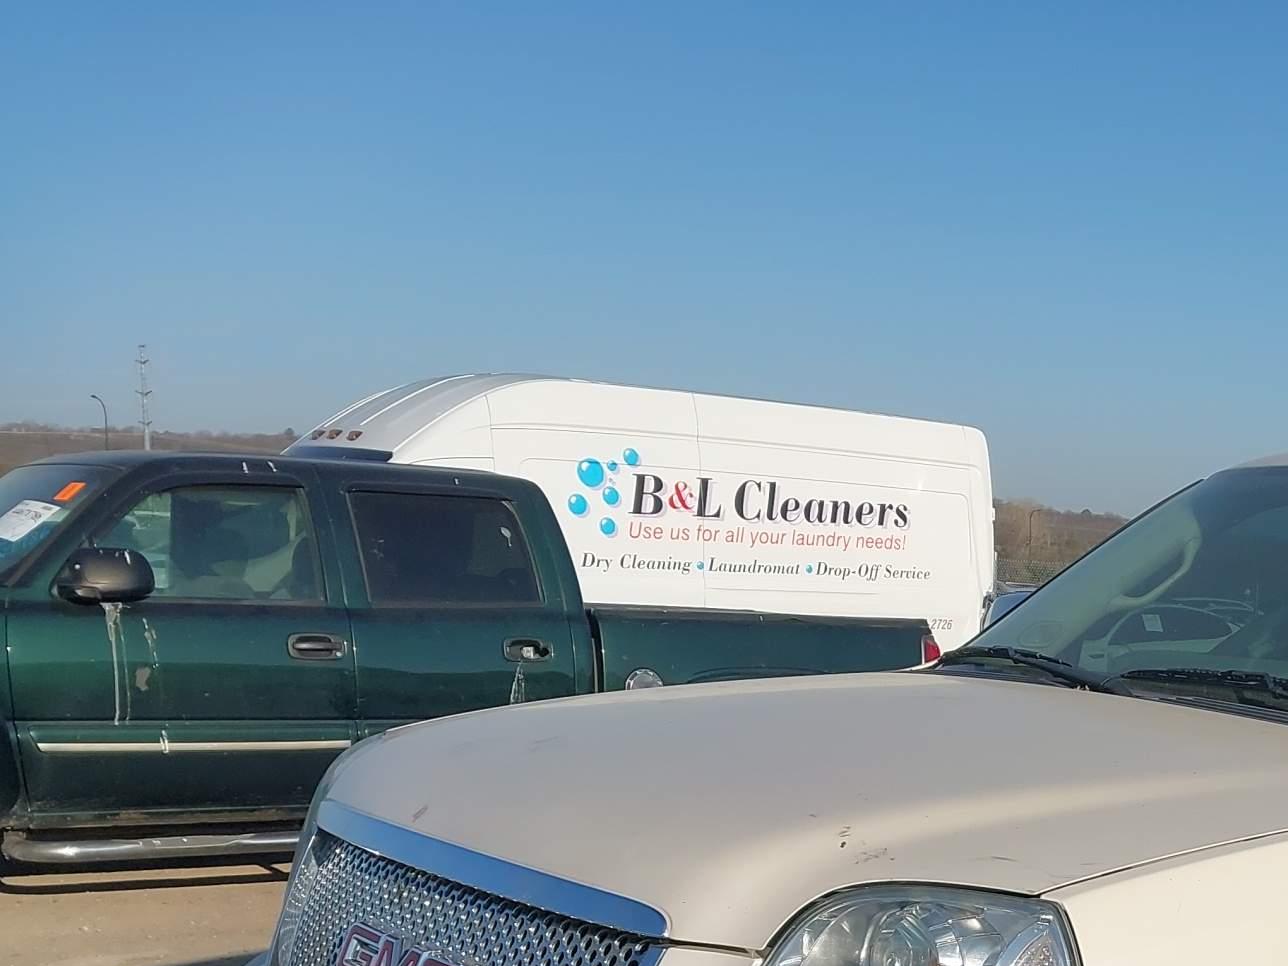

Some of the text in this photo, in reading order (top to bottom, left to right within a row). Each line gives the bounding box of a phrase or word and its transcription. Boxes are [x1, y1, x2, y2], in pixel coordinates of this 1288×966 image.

[627, 473, 909, 528] B&L Cleaners
[629, 521, 907, 552] Use us for all your laundry needs!
[581, 552, 931, 582] Dry Cleaning Laundromat Drop-Off Service
[930, 618, 953, 630] 2726
